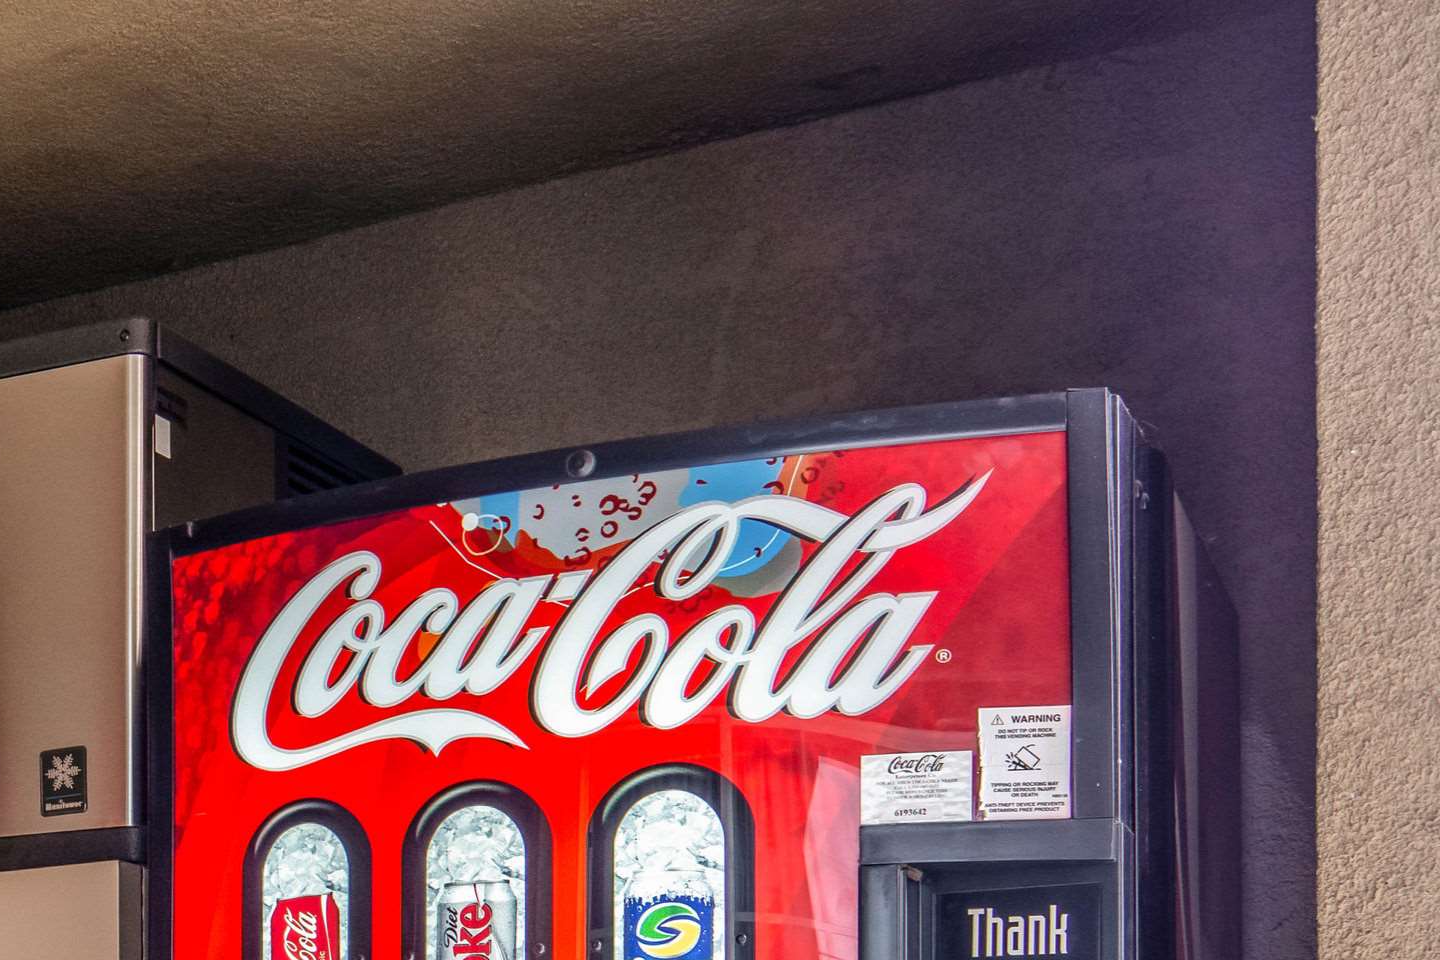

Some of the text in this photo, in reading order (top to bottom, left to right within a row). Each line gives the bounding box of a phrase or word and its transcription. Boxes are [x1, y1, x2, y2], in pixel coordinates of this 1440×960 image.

[229, 467, 994, 771] Coca-Cola
[1011, 714, 1061, 723] WARNING
[444, 907, 458, 948] Diet
[968, 904, 1068, 957] Thank
